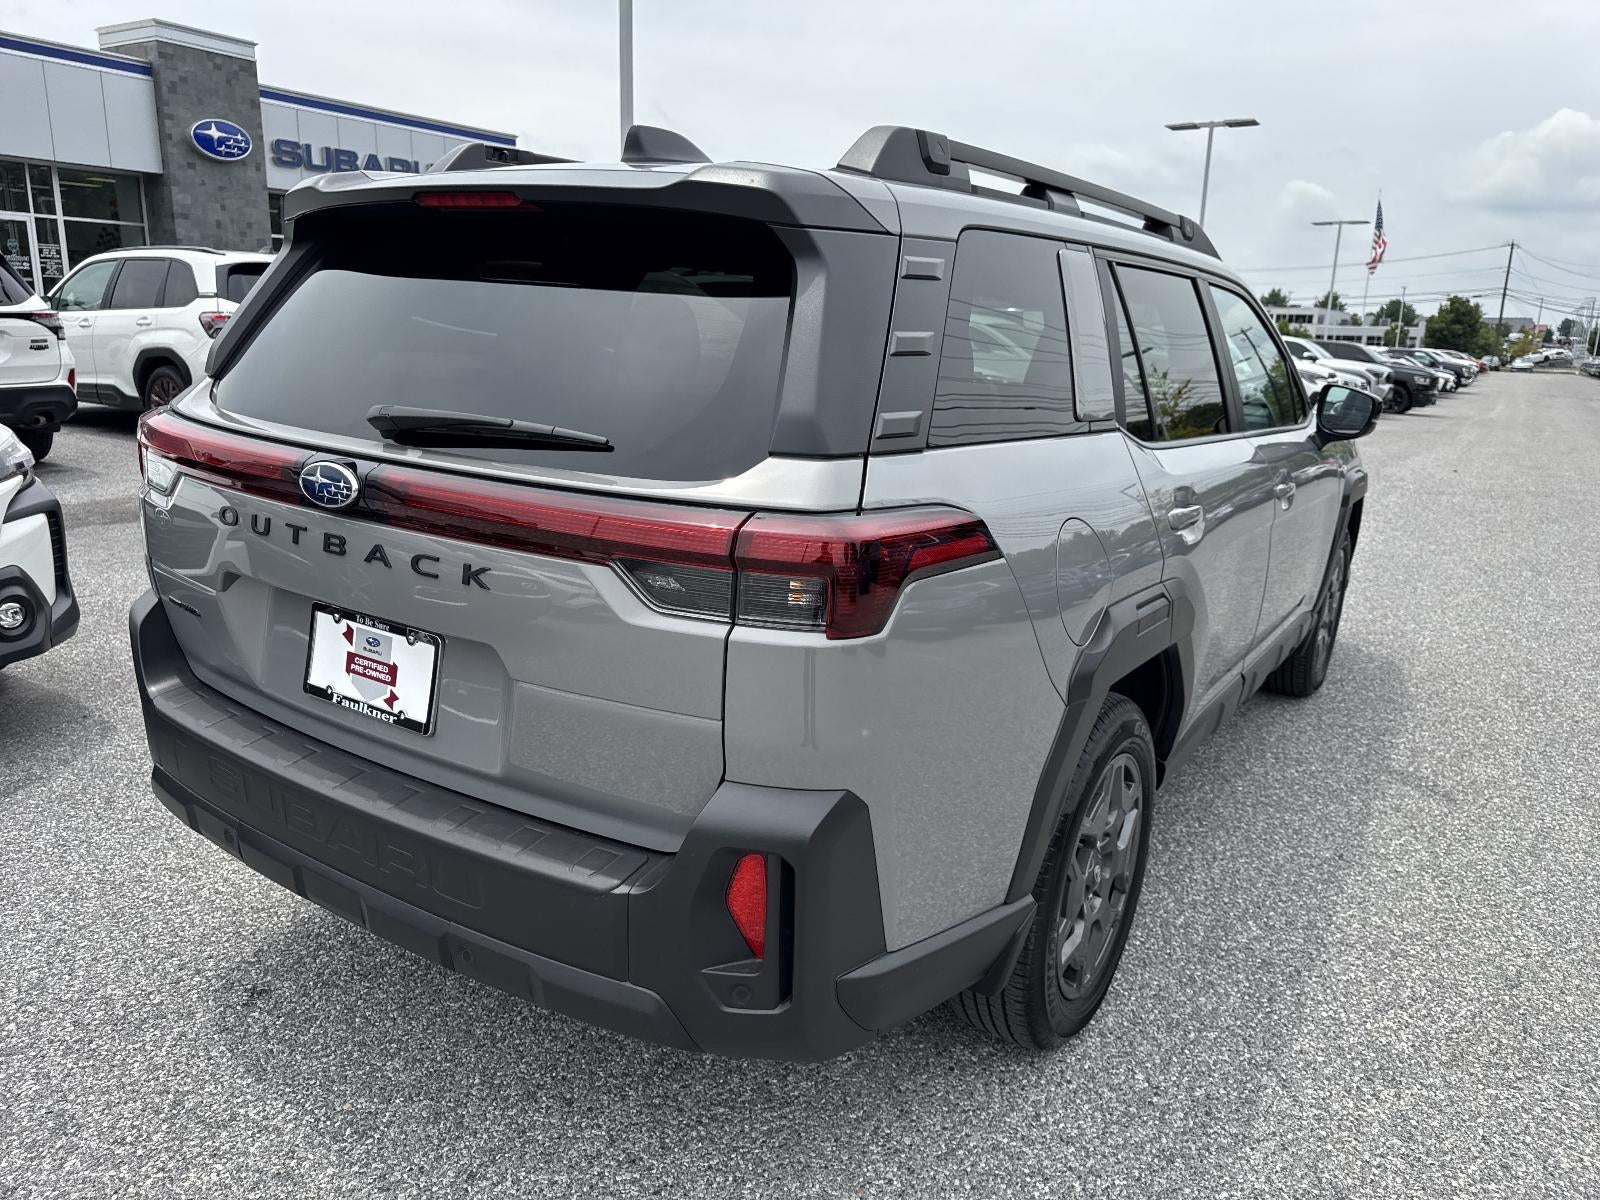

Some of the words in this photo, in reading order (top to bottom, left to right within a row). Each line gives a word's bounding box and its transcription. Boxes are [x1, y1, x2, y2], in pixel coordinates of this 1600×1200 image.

[218, 505, 492, 590] OUTBACK
[356, 615, 364, 624] To
[365, 617, 374, 626] Be
[374, 620, 390, 632] Sure
[362, 646, 383, 657] SUBARU
[350, 664, 392, 682] PRE-OWNED
[354, 657, 389, 673] CERTIFIED
[332, 692, 398, 724] Faulkner
[208, 755, 487, 911] SUBARU
